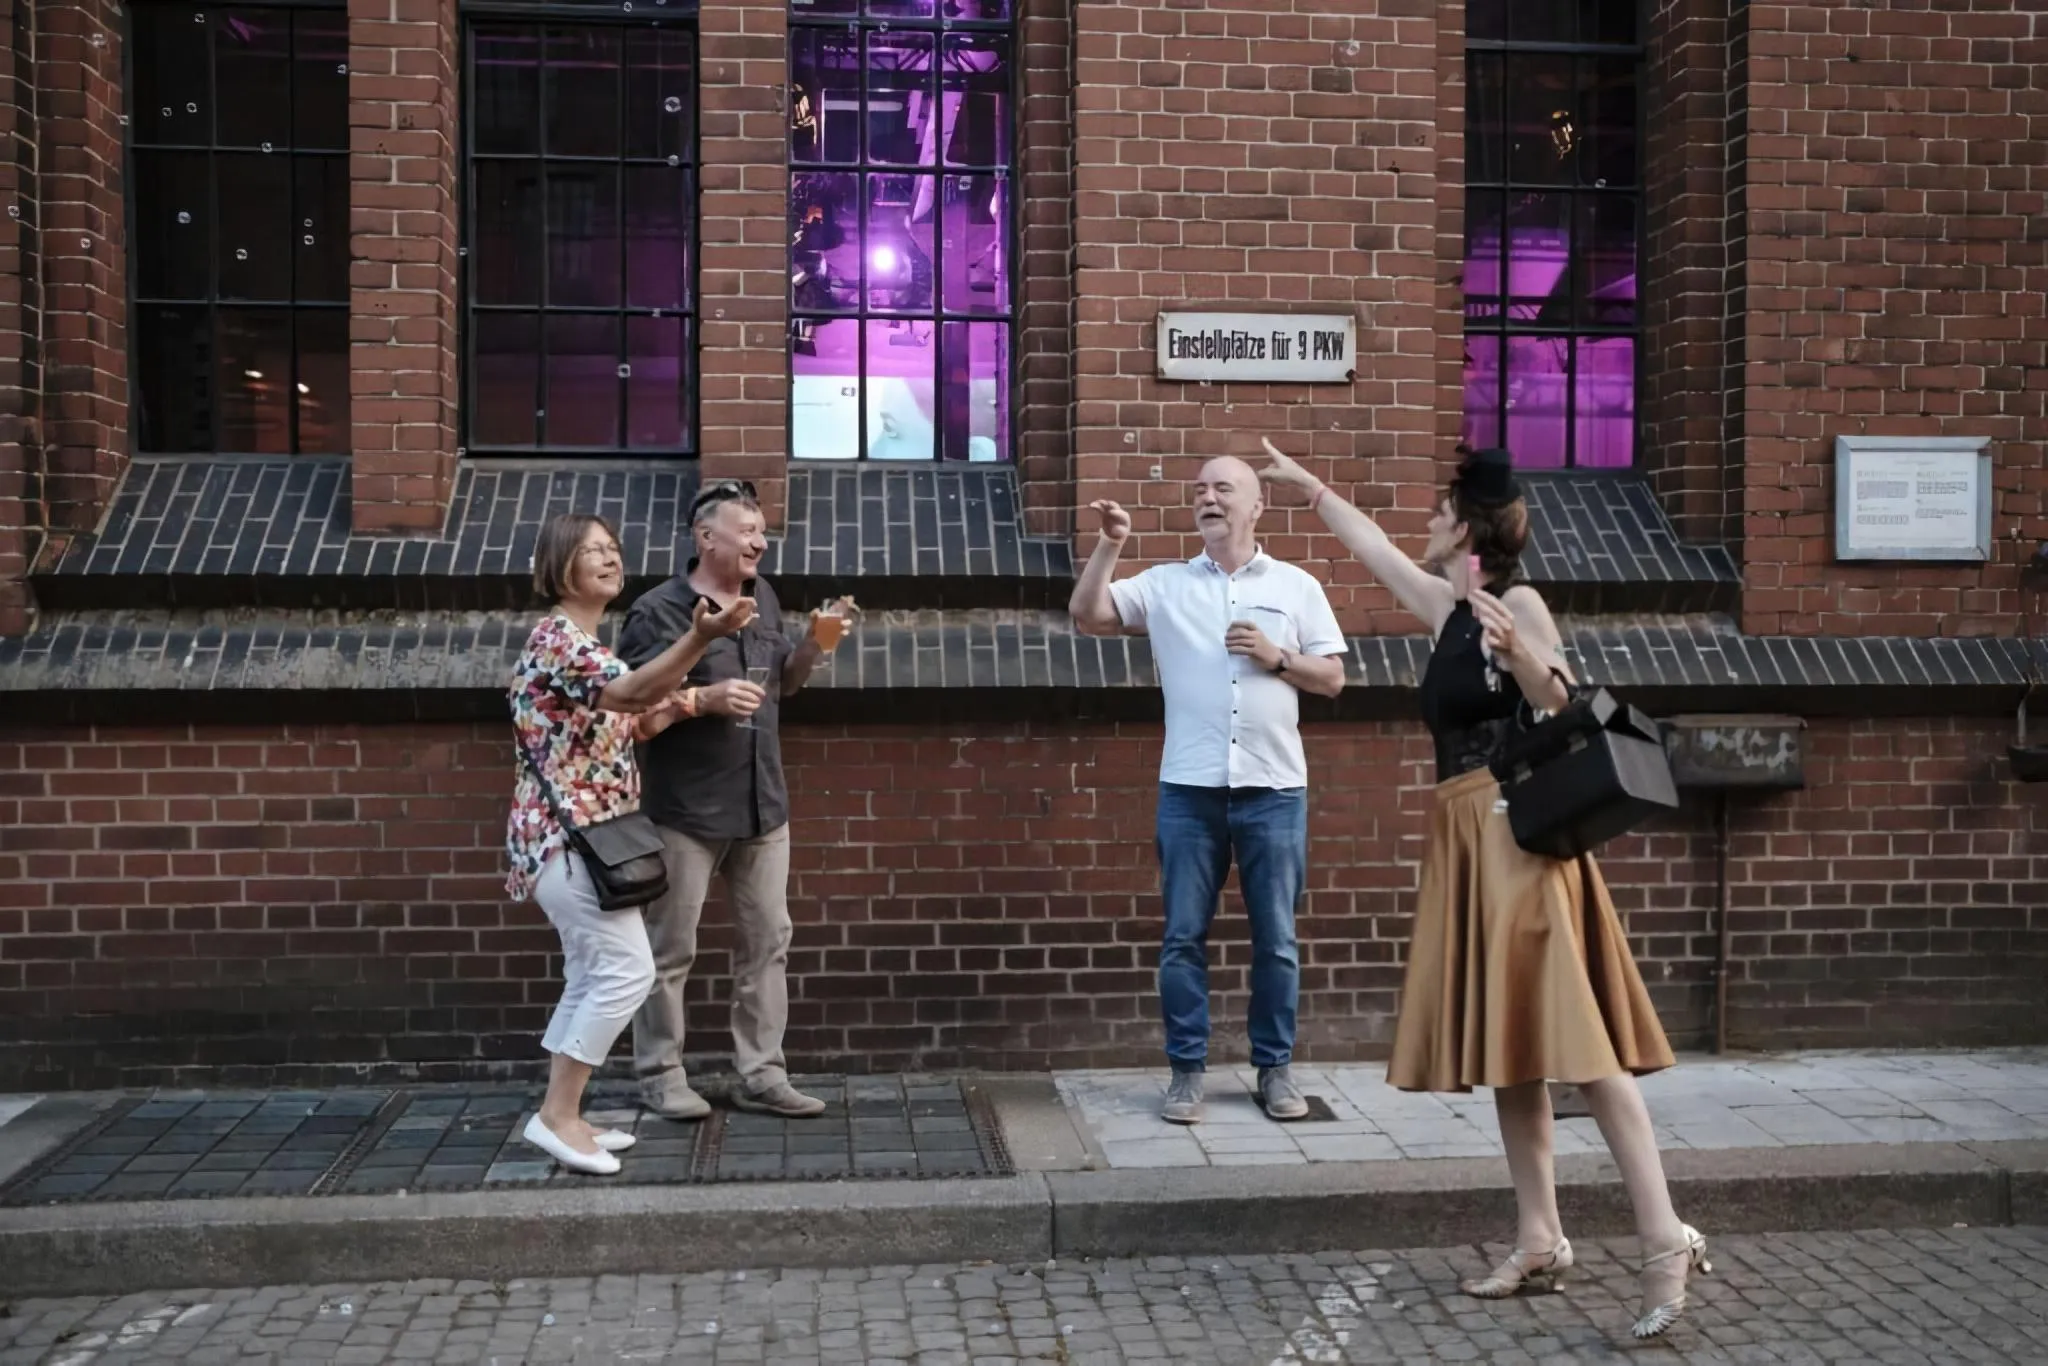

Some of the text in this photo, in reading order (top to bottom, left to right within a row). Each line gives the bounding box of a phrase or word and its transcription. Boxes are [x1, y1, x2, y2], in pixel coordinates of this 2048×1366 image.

[1168, 328, 1345, 363] Einstellplätze für 9 PKW
